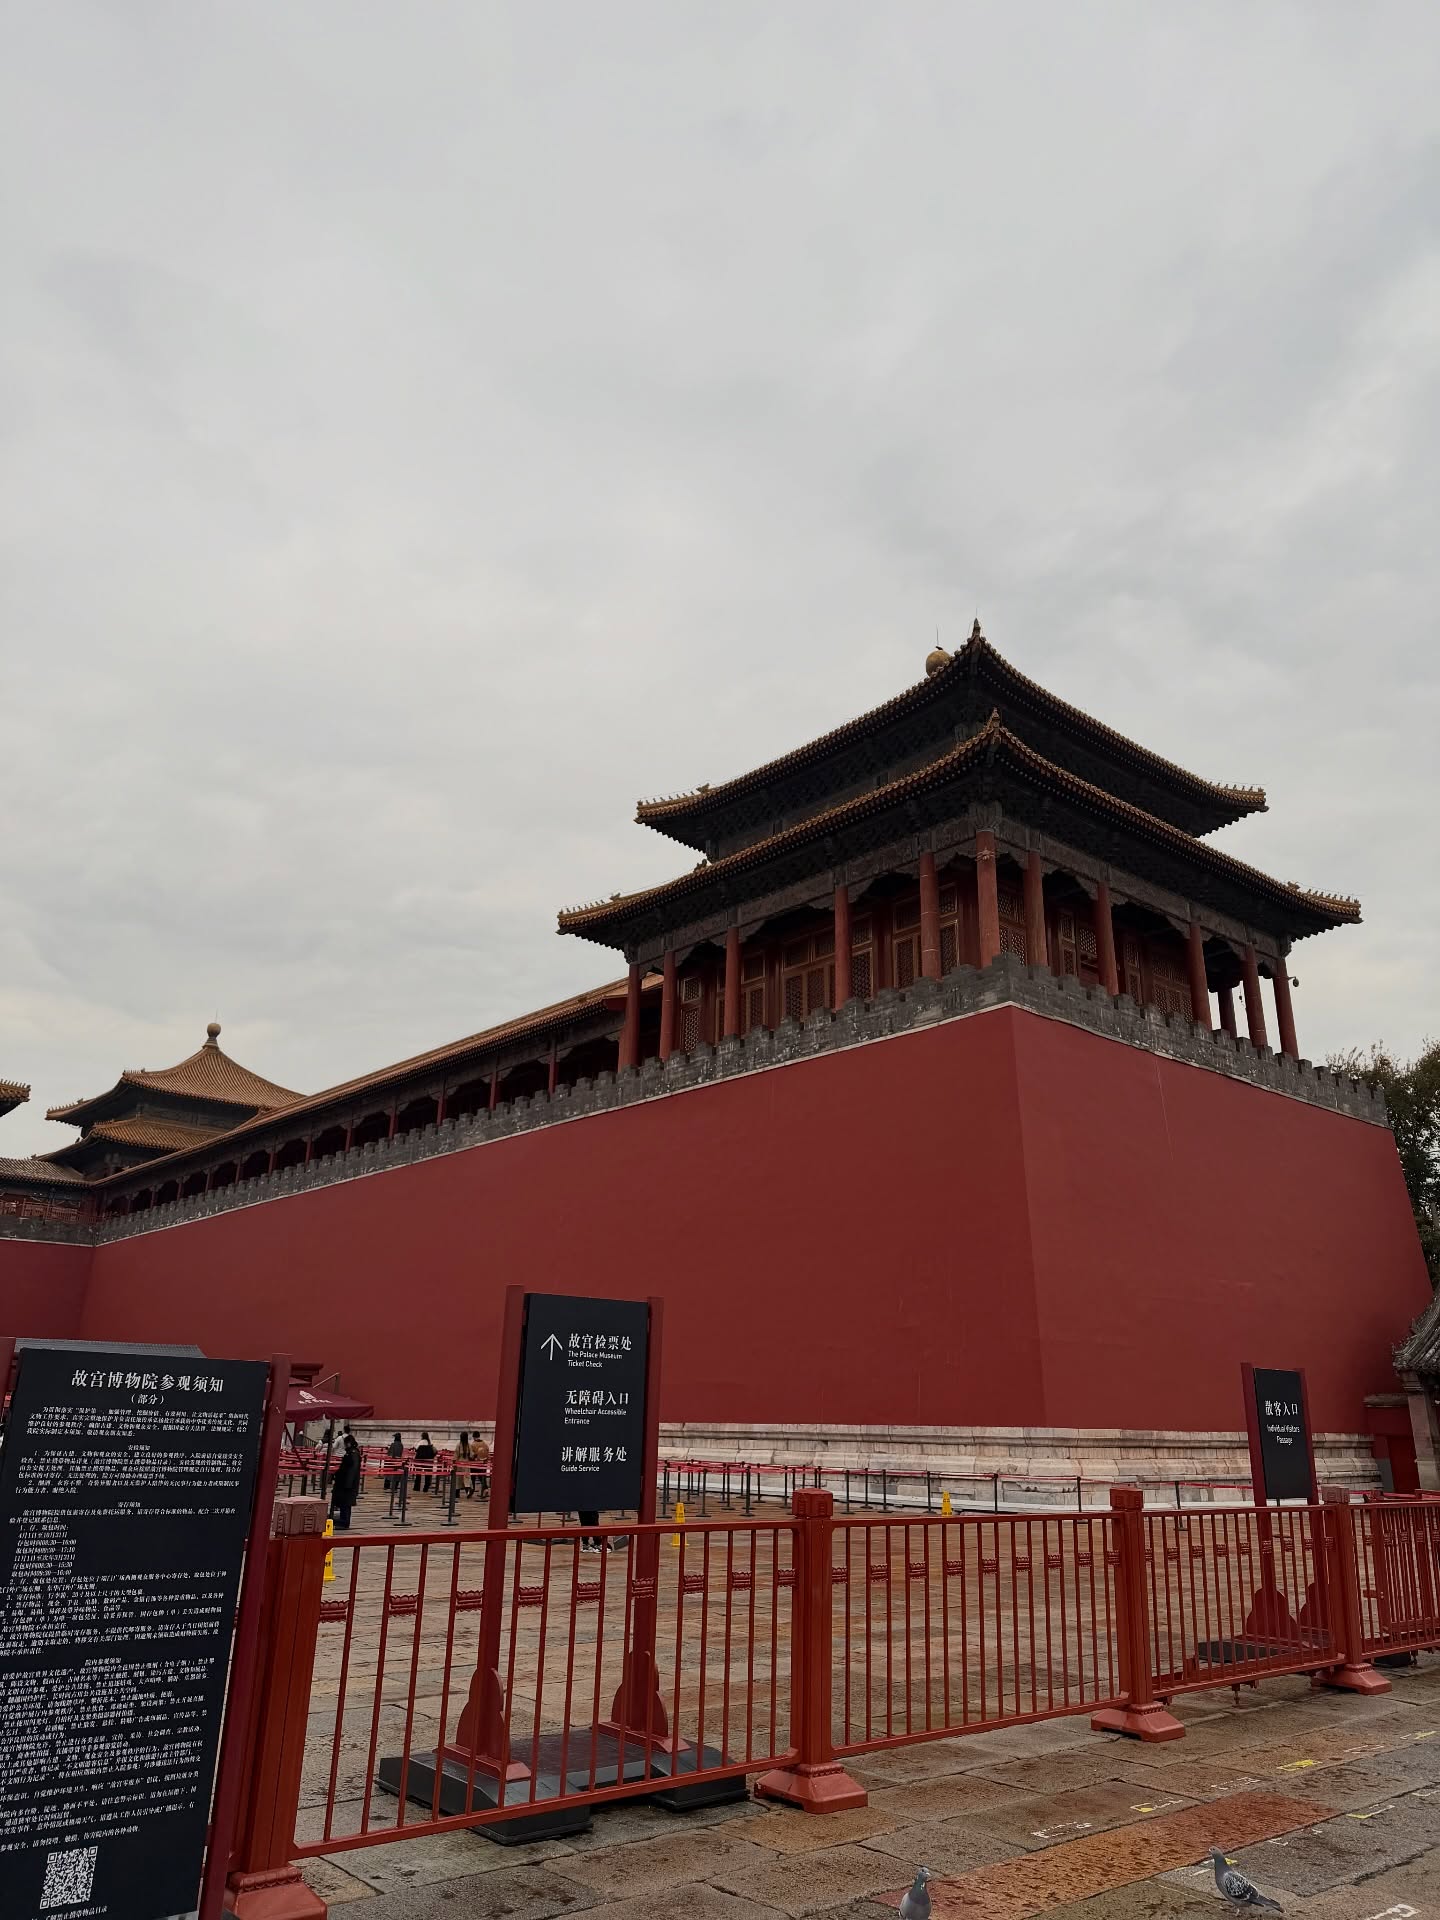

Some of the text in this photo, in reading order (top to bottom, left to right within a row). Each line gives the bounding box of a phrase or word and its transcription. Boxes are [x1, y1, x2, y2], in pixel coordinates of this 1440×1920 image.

[568, 1333, 632, 1351] 故宫检票处
[568, 1350, 623, 1360] The Palace Museum
[585, 1360, 603, 1368] Check
[71, 1369, 224, 1393] 故宫博物院参观须知
[565, 1390, 629, 1406] 无障碍入口
[564, 1407, 627, 1416] Wheelchair Accessible
[1265, 1400, 1298, 1417] 散客入口
[564, 1417, 590, 1425] Entrance
[1276, 1435, 1293, 1446] Passage
[561, 1446, 627, 1463] 讲解服务处
[560, 1464, 578, 1472] Guide
